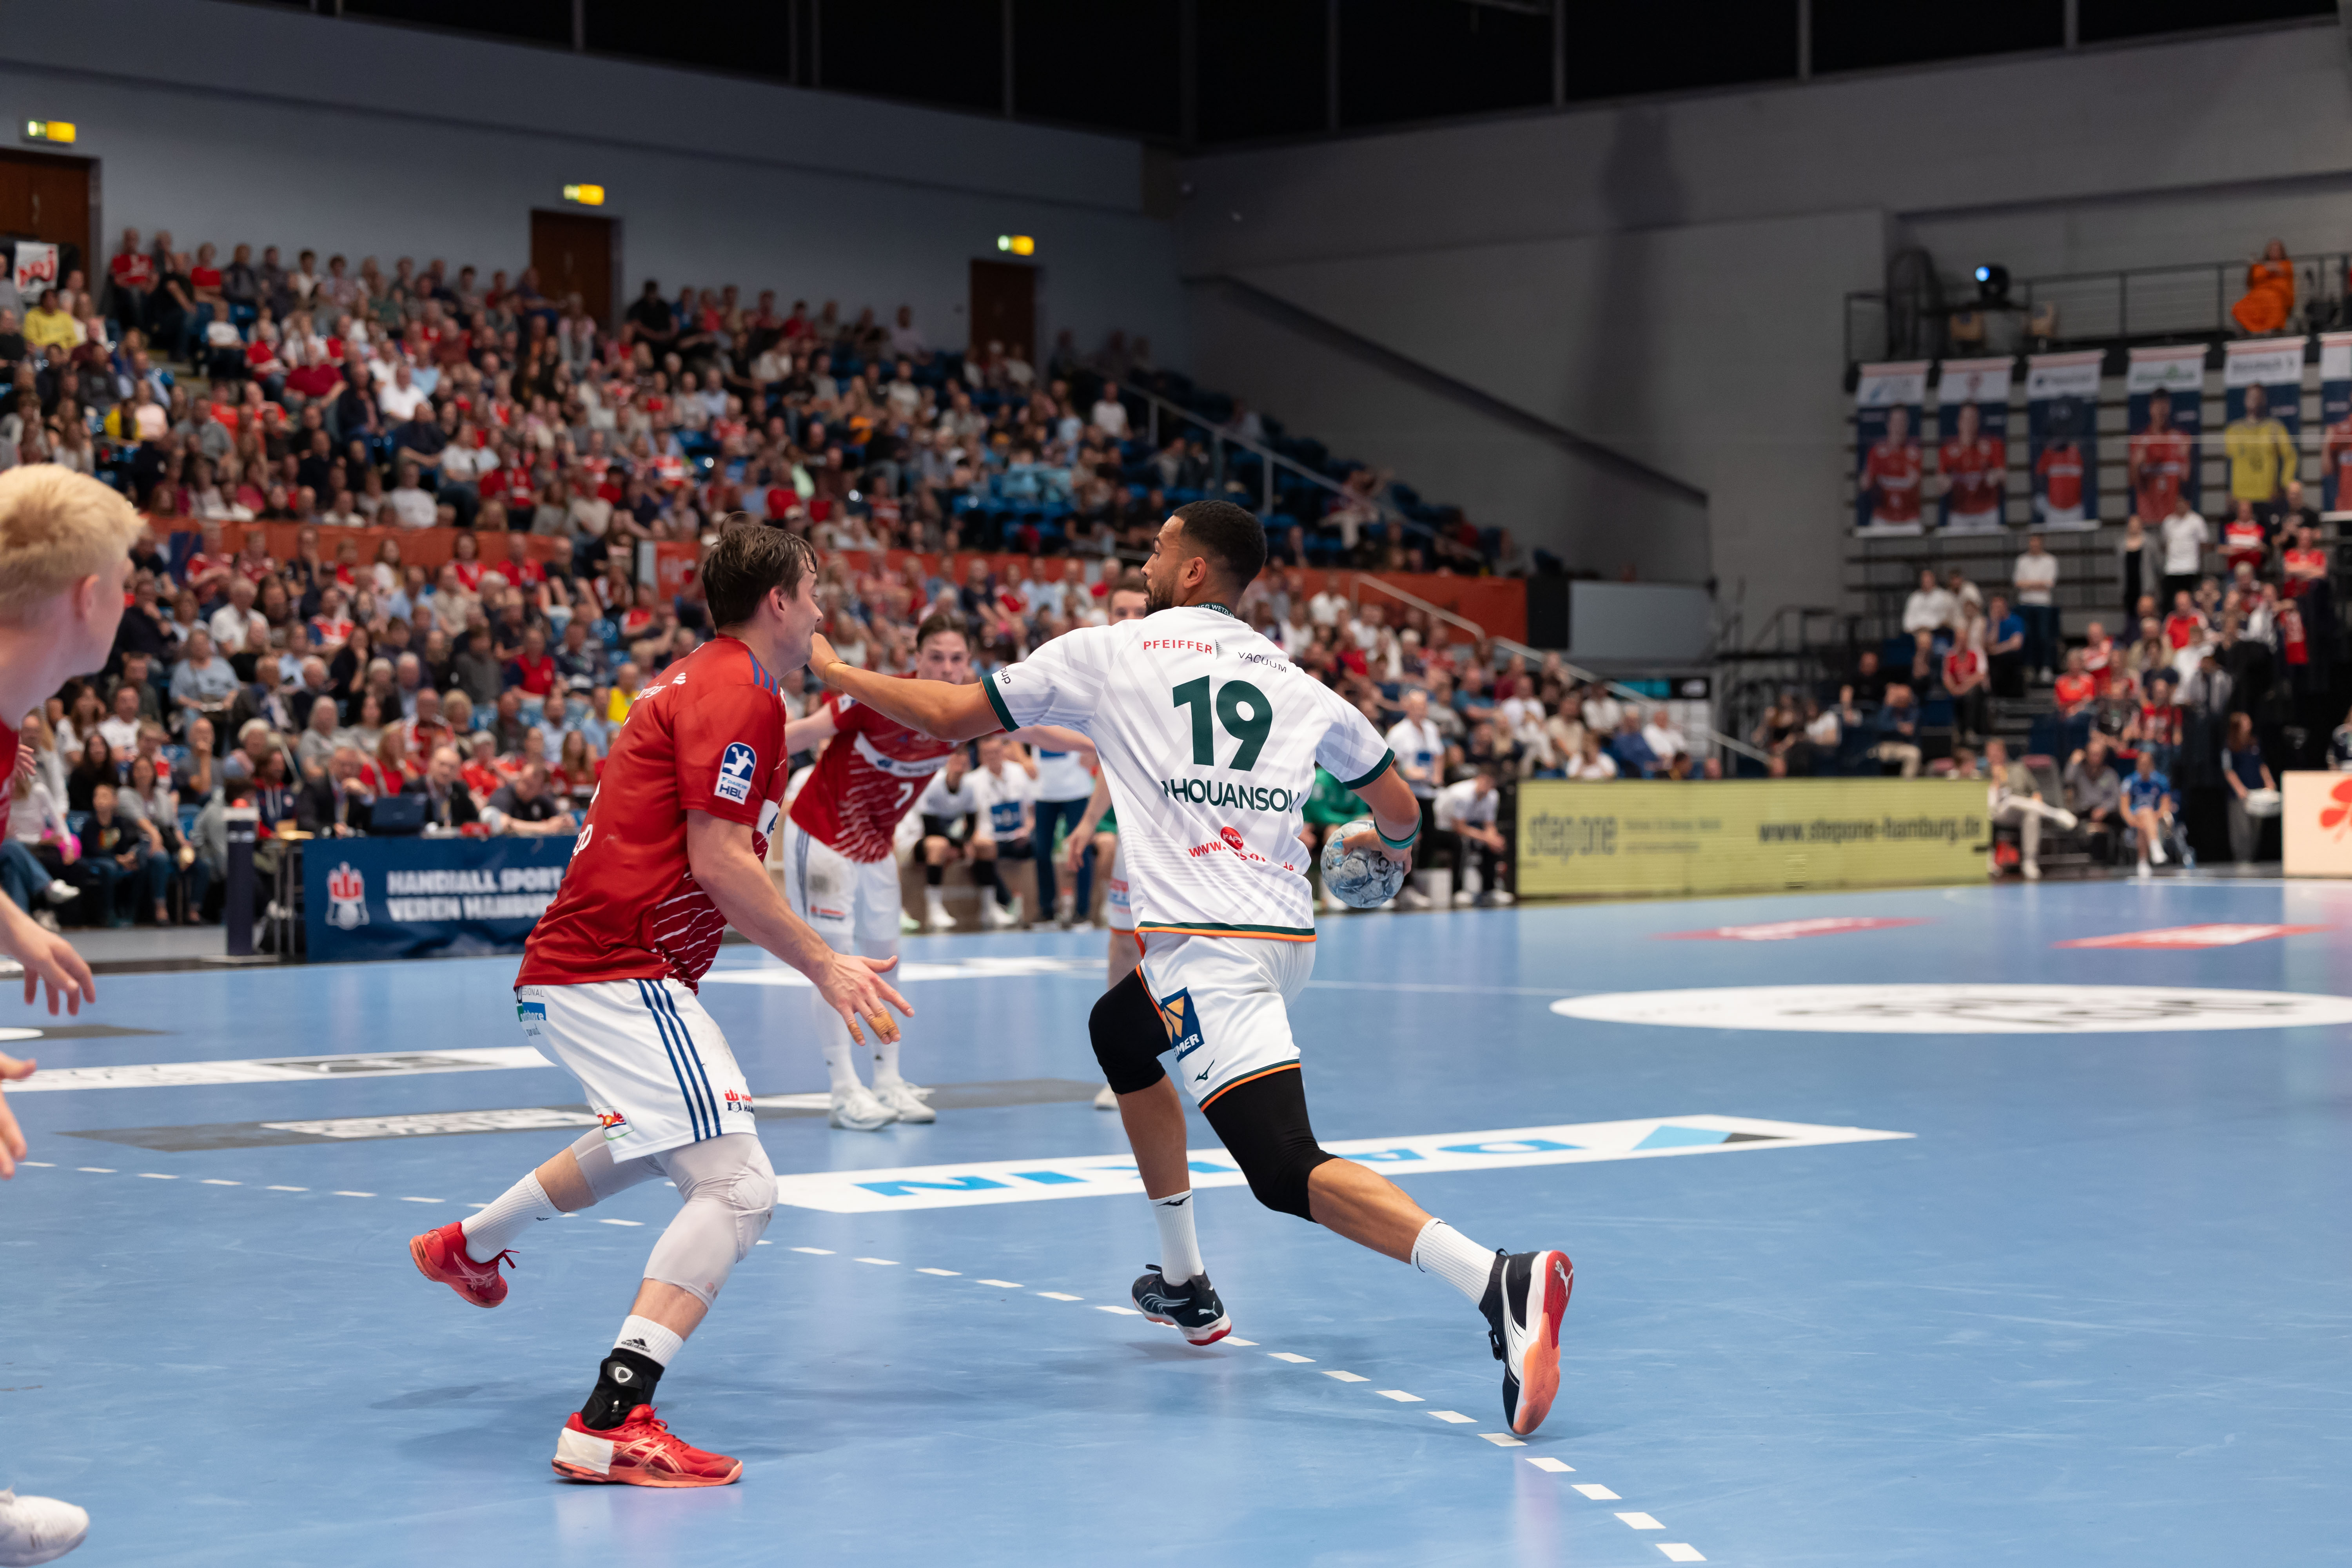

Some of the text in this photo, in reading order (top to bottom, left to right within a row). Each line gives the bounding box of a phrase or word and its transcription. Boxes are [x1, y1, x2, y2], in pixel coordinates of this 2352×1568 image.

[1212, 604, 1234, 618] WETZLAR
[1143, 640, 1287, 673] PFEIFFER VACUUM
[1172, 675, 1272, 771] 19
[719, 784, 743, 800] HBL
[893, 782, 914, 809] 7
[1161, 779, 1300, 814] HOUANSOU
[387, 866, 564, 895] HANDBALL SPORT
[621, 1341, 651, 1352] adidas
